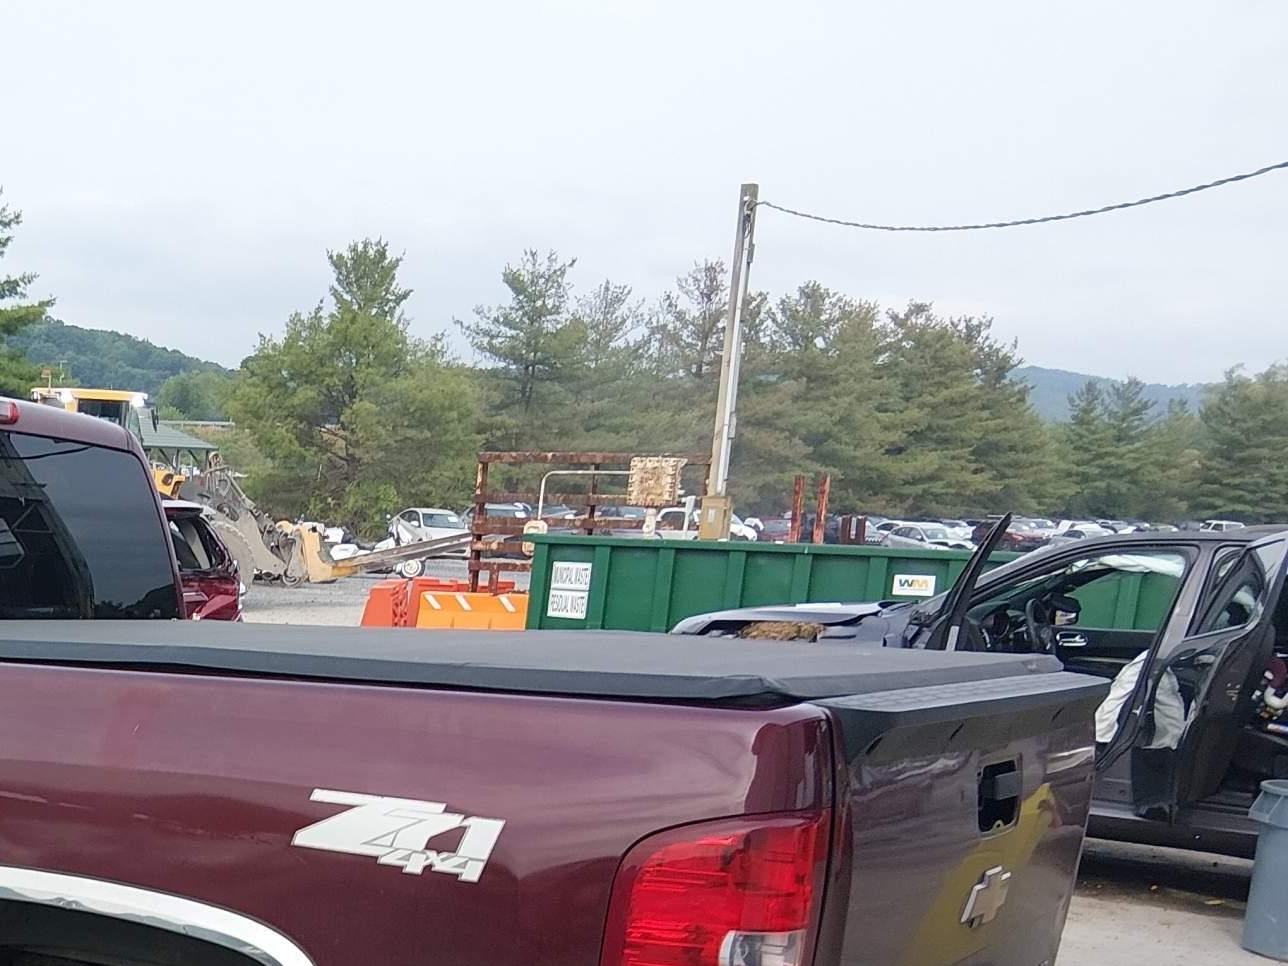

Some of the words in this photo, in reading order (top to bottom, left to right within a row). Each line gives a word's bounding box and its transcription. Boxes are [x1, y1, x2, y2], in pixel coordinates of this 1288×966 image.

[574, 567, 589, 586] WASTE
[898, 578, 929, 588] WM
[570, 595, 586, 615] WASTE
[290, 788, 506, 866] Z71
